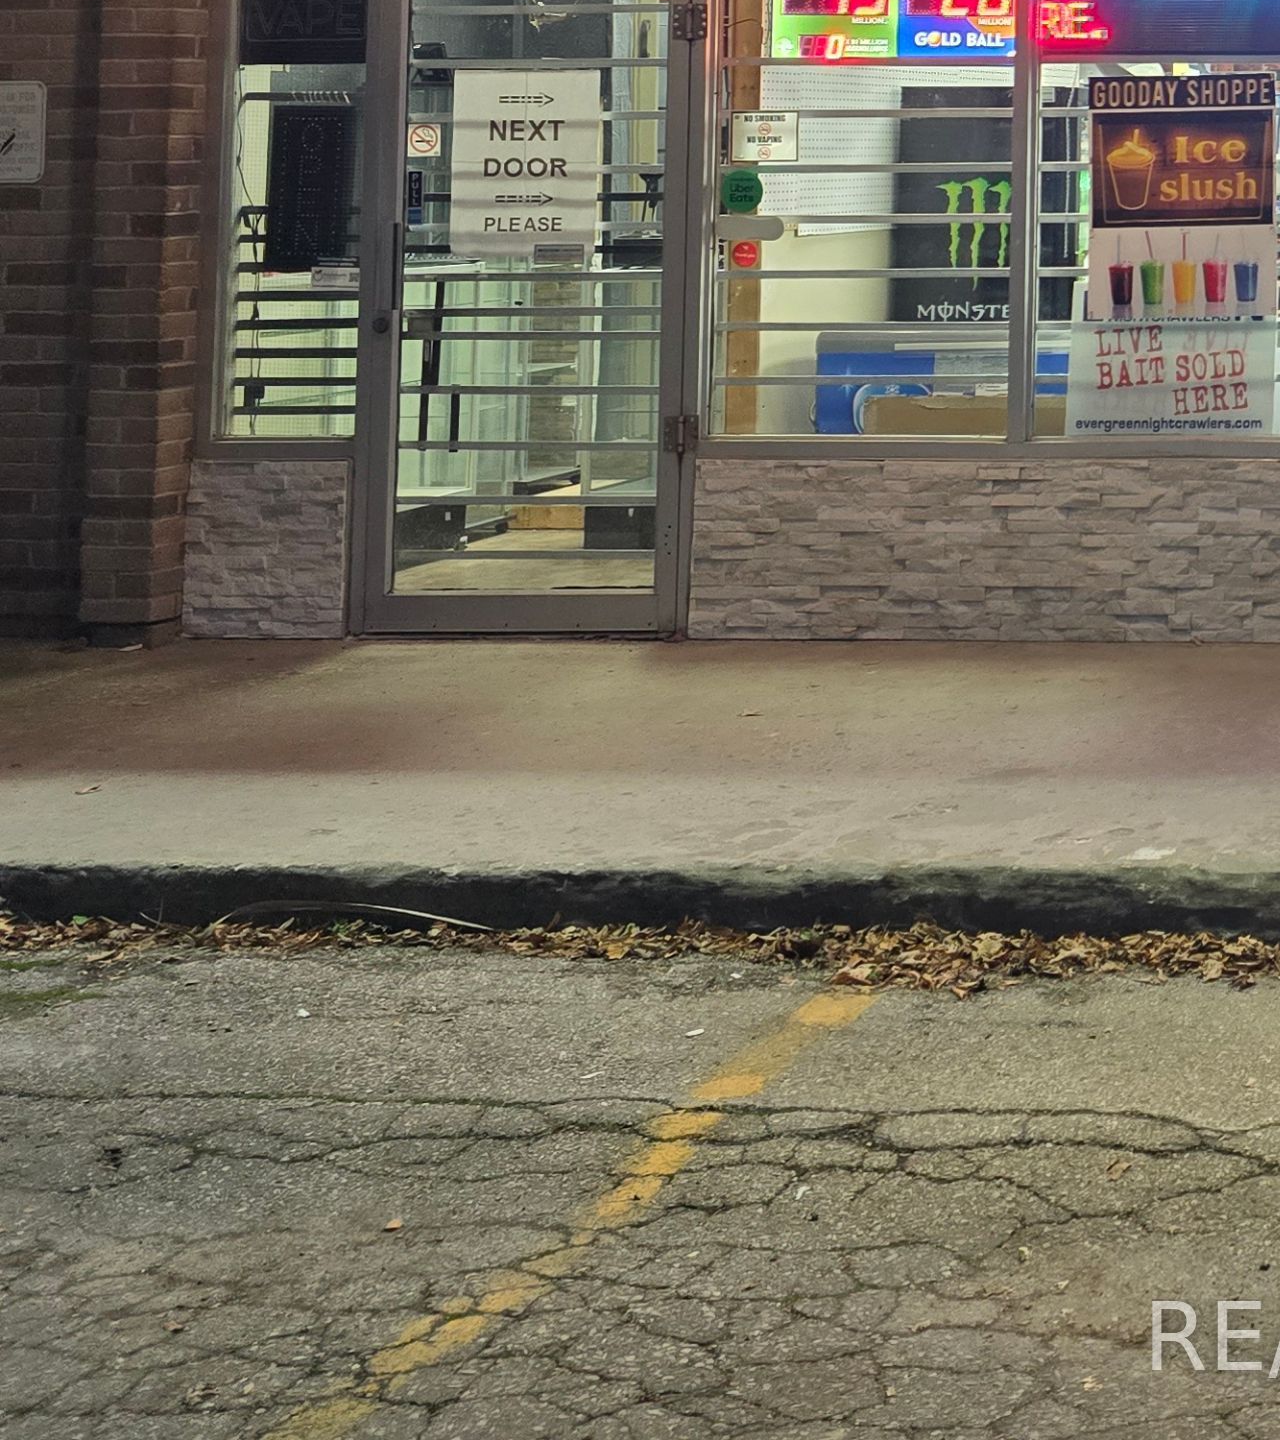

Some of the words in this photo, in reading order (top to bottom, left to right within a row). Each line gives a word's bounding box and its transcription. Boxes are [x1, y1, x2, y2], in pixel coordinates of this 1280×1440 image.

[255, 0, 362, 35] VAPE
[914, 31, 962, 47] GOLD
[966, 32, 1006, 47] BALL
[1093, 79, 1179, 107] GOODAY
[1186, 78, 1272, 106] SHOPPE
[744, 114, 753, 122] NO
[755, 114, 786, 122] SMOKING
[489, 120, 565, 141] NEXT
[747, 136, 757, 144] NO
[757, 136, 783, 144] VAPING
[1174, 136, 1246, 164] Ice
[483, 157, 568, 177] DOOR
[411, 173, 419, 206] PULL
[729, 182, 754, 193] Uber
[1160, 171, 1258, 202] slush
[729, 193, 754, 204] Eats
[484, 217, 563, 232] PLEASE
[1094, 324, 1162, 357] LIVE
[1096, 357, 1165, 390] BAIT
[1175, 350, 1245, 382] SOLD
[1172, 382, 1249, 415] HERE
[1075, 417, 1262, 432] evergreennightcrawlers.com
